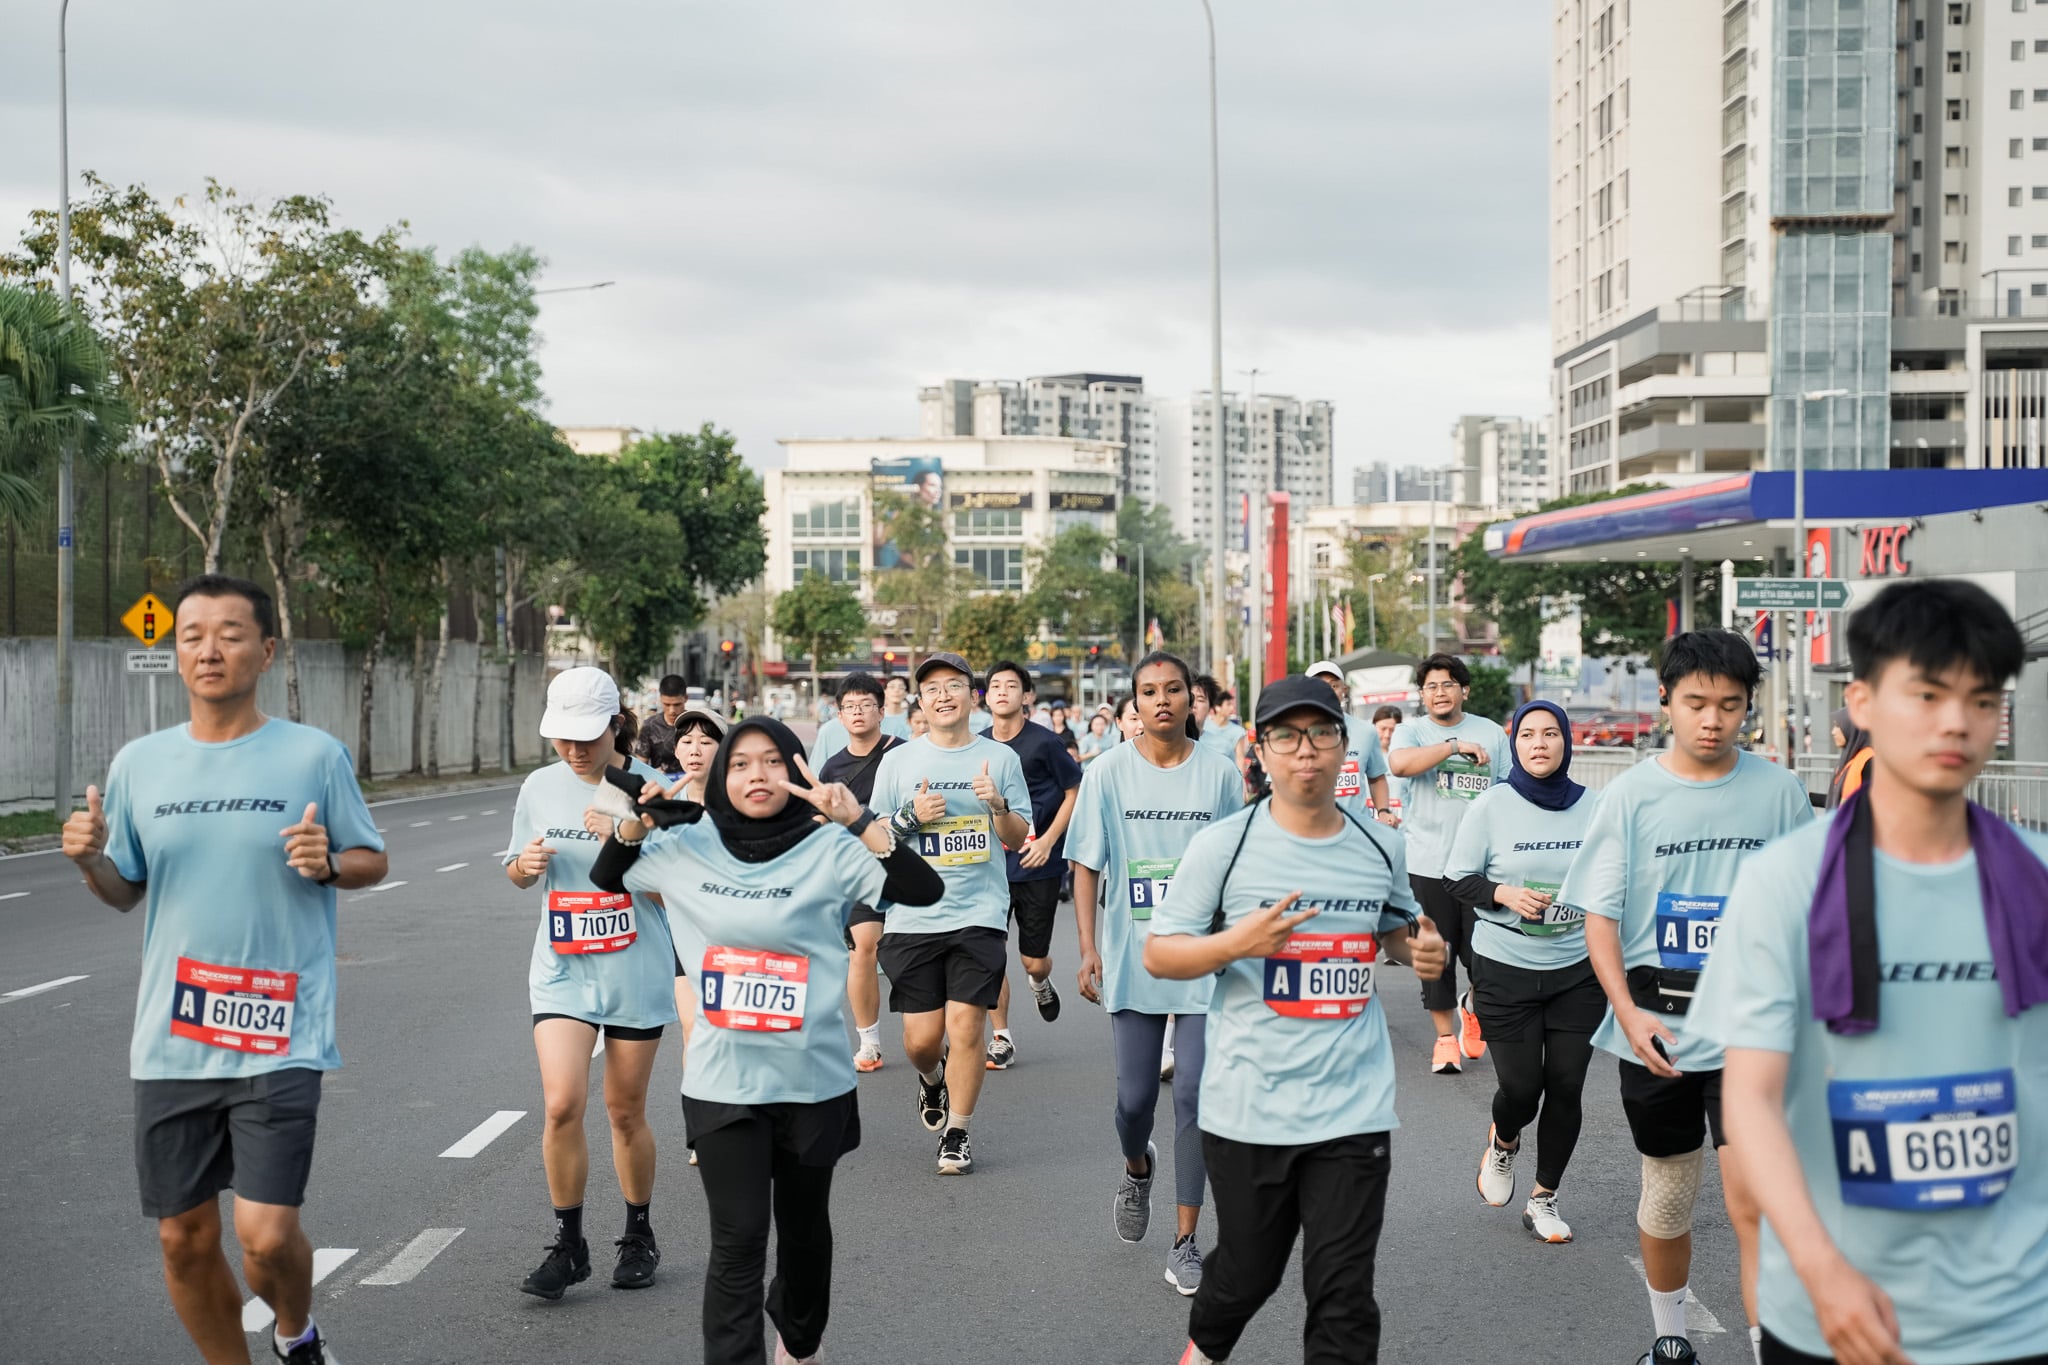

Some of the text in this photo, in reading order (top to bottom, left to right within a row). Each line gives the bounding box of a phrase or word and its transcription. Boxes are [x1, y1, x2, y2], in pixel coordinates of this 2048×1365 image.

[1859, 525, 1909, 575] KFC
[1337, 774, 1358, 787] 290
[1457, 775, 1489, 791] 63193
[153, 798, 288, 819] SKECHERS
[1125, 809, 1213, 821] SKECHERS
[545, 828, 599, 842] SKECH
[924, 833, 987, 853] A 68149
[1513, 840, 1583, 852] SKECHE
[1655, 837, 1767, 858] SKECHERS
[699, 882, 794, 899] SKECHERS
[1133, 882, 1146, 904] B
[553, 912, 630, 938] B 71070
[1663, 921, 1679, 948] A
[1272, 965, 1371, 995] A 61092
[705, 976, 797, 1012] B 71075
[179, 988, 286, 1032] A 61034
[1848, 1121, 2013, 1174] A 66139
